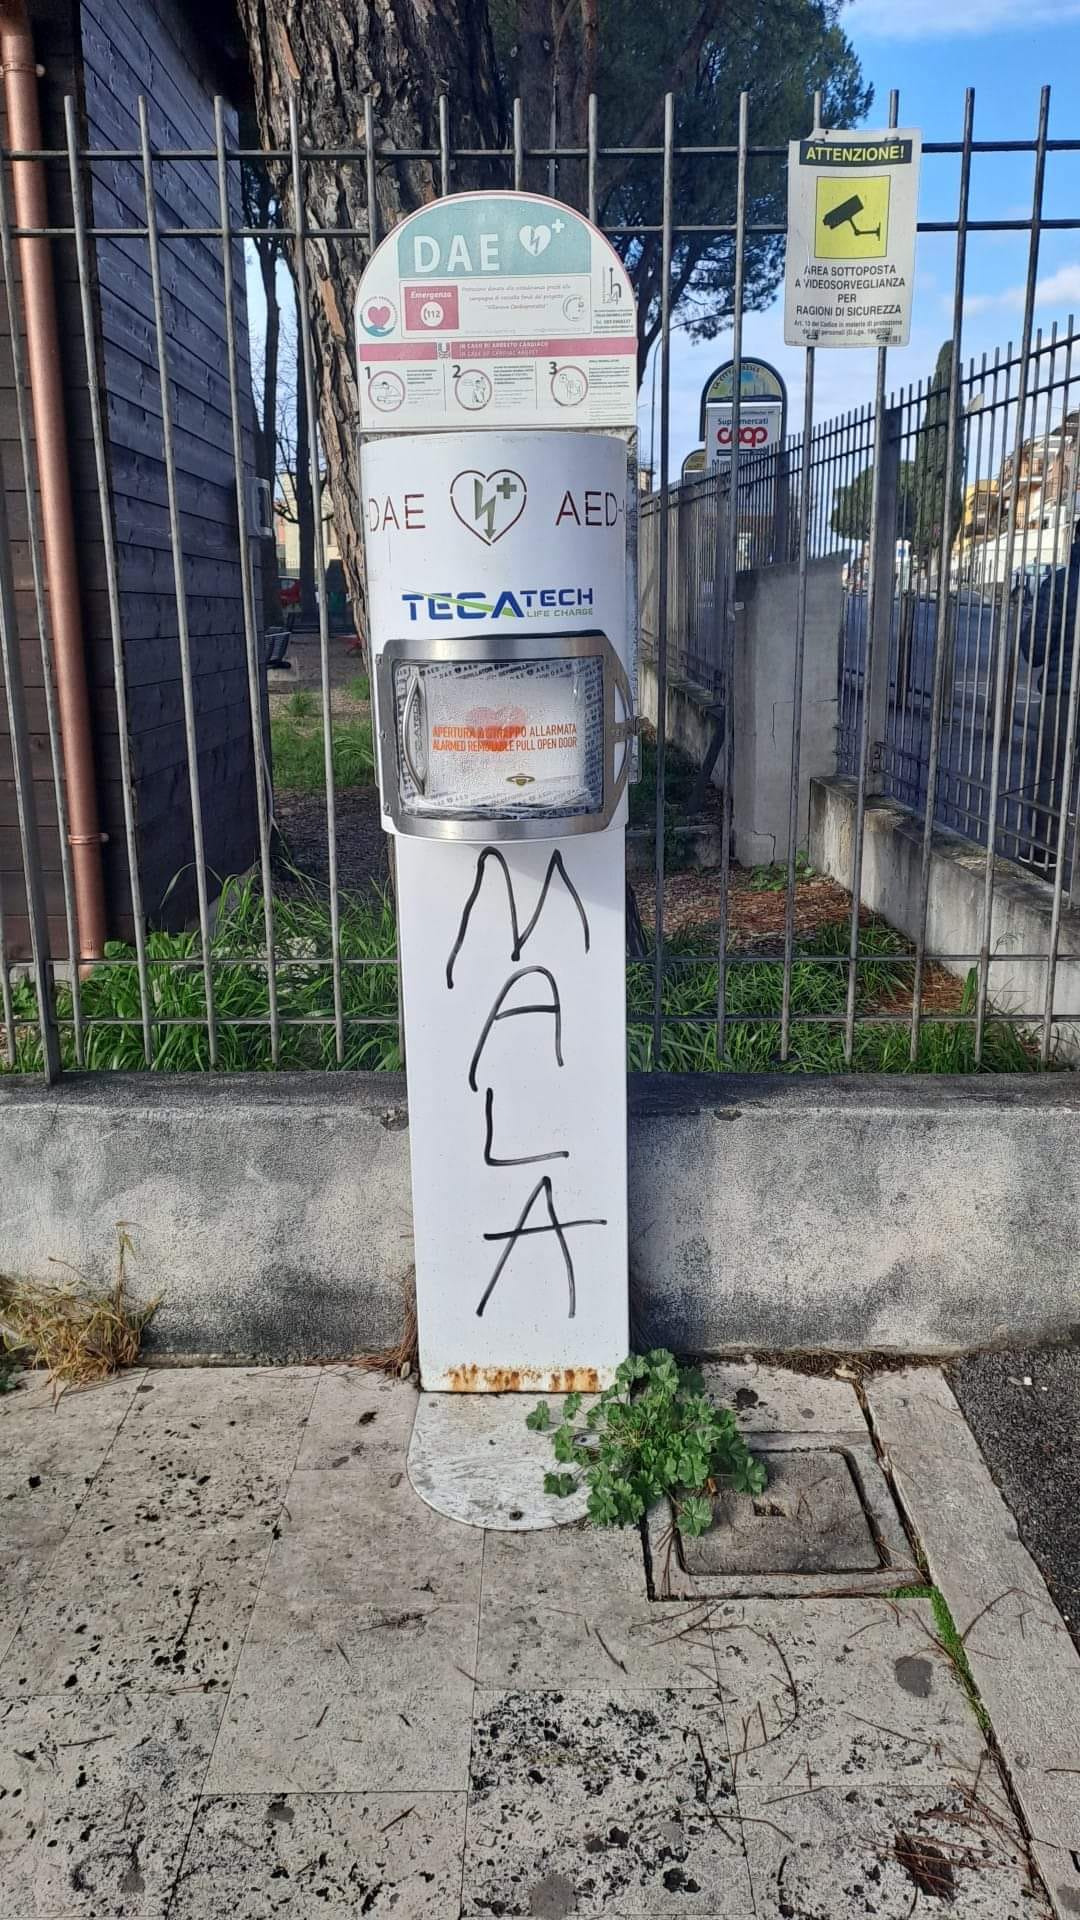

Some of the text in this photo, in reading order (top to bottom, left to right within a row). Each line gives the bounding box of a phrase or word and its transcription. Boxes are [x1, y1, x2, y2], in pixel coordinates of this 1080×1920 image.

[805, 145, 904, 161] ATTENZIONE!
[413, 233, 500, 273] DAE
[804, 264, 896, 276] AREA SOTTOPOSTA
[795, 277, 905, 290] A VIDEOSORVEGLIANZA
[410, 291, 452, 300] Emergenza
[837, 294, 857, 303] PER
[427, 310, 440, 318] 112
[796, 304, 901, 316] RAGIONI DI SICUREZZA
[364, 366, 371, 379] 1
[452, 364, 462, 378] 2
[548, 361, 558, 375] 3
[717, 417, 768, 426] Supmercati
[526, 608, 593, 618] LIFE CHARGE
[432, 725, 477, 739] APERTURA
[529, 722, 577, 737] ALLARMATA
[432, 739, 467, 751] ALARMED
[516, 739, 535, 751] PULL
[537, 738, 557, 750] OPEN
[558, 736, 577, 748] DOOR
[446, 846, 607, 1319] MALA
